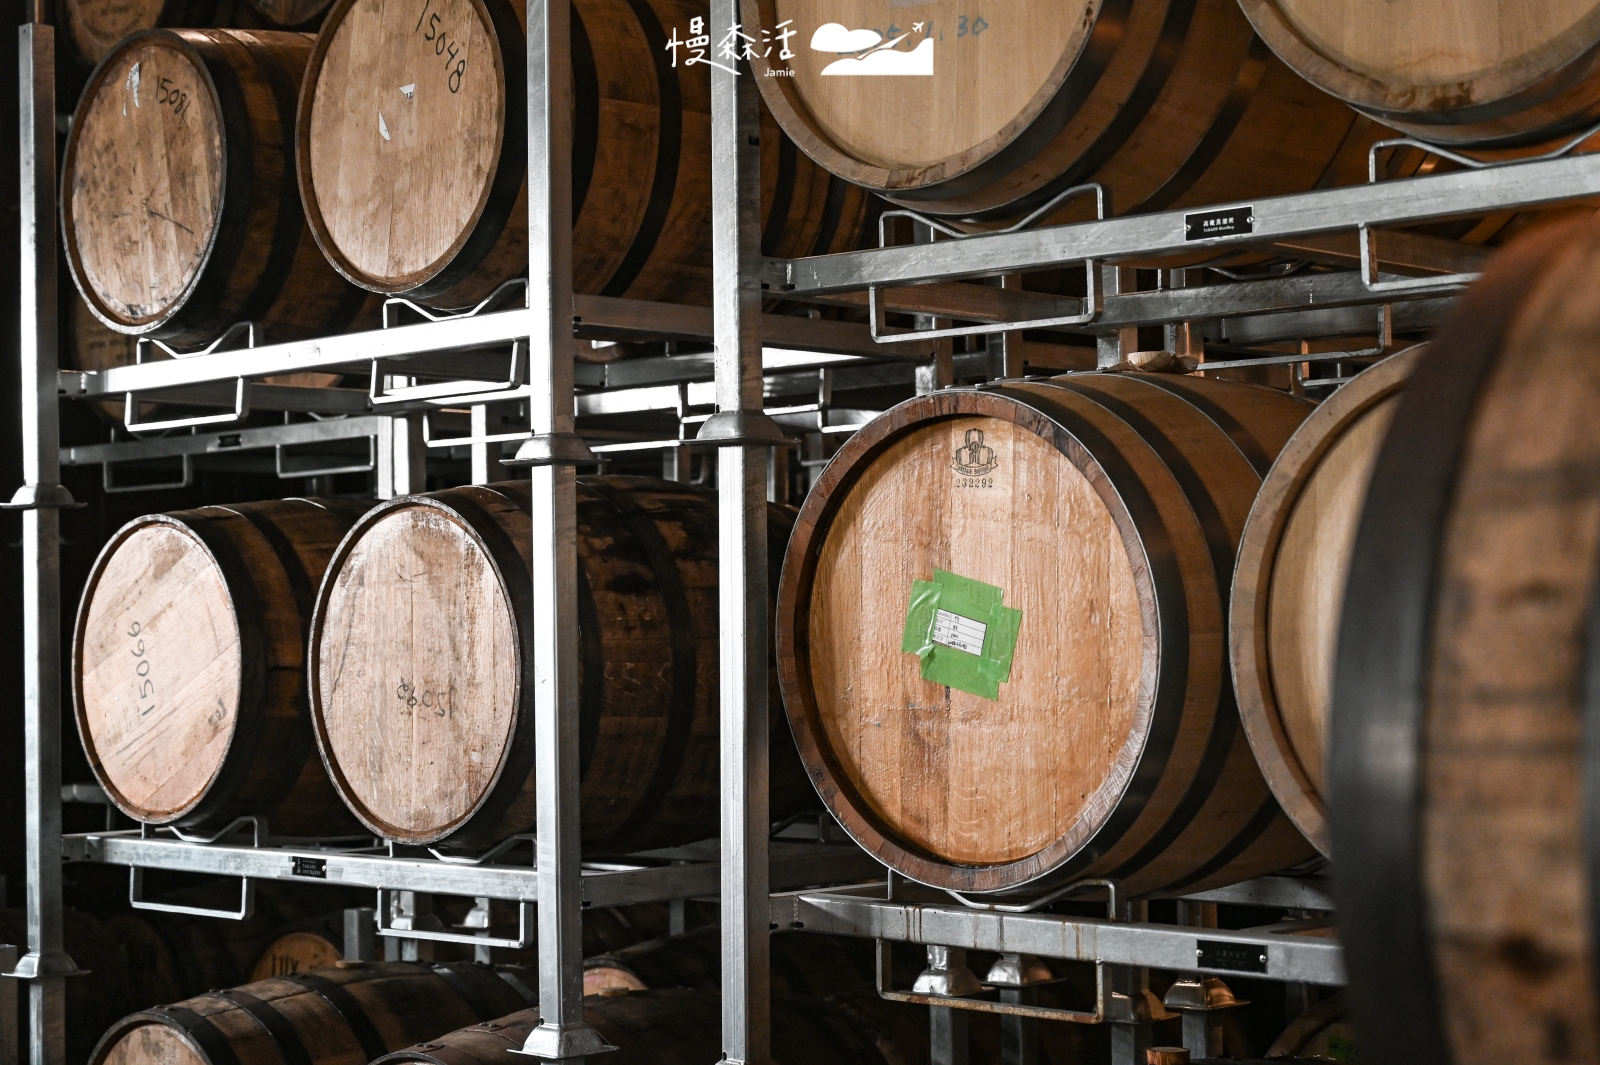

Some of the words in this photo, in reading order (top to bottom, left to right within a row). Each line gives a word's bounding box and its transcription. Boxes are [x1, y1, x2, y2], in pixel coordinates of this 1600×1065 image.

[415, 0, 466, 94] 15048
[955, 478, 994, 489] 232292
[127, 621, 155, 716] 15066
